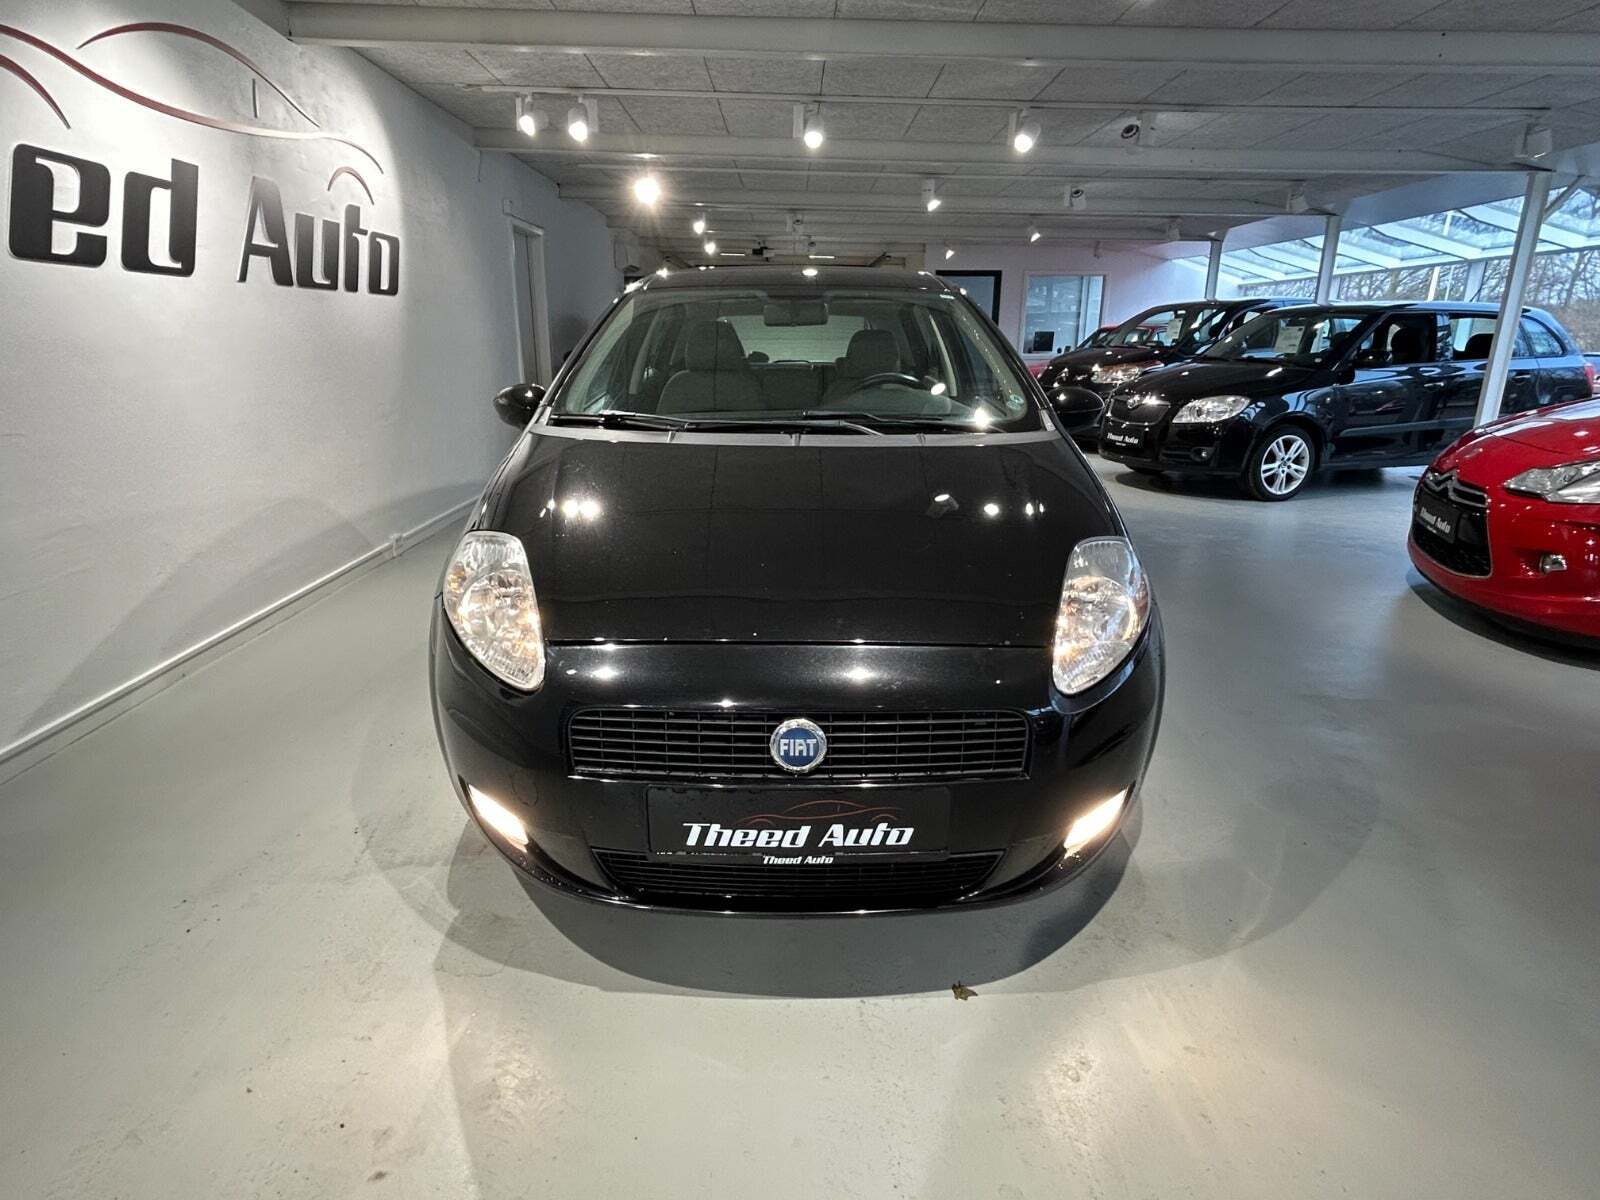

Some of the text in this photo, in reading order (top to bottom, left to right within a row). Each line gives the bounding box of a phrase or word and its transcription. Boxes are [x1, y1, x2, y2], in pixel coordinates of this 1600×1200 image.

[237, 175, 400, 297] Auto
[779, 738, 818, 757] FIAT
[682, 822, 915, 848] Theed Auto
[762, 855, 834, 865] Theed Auto
